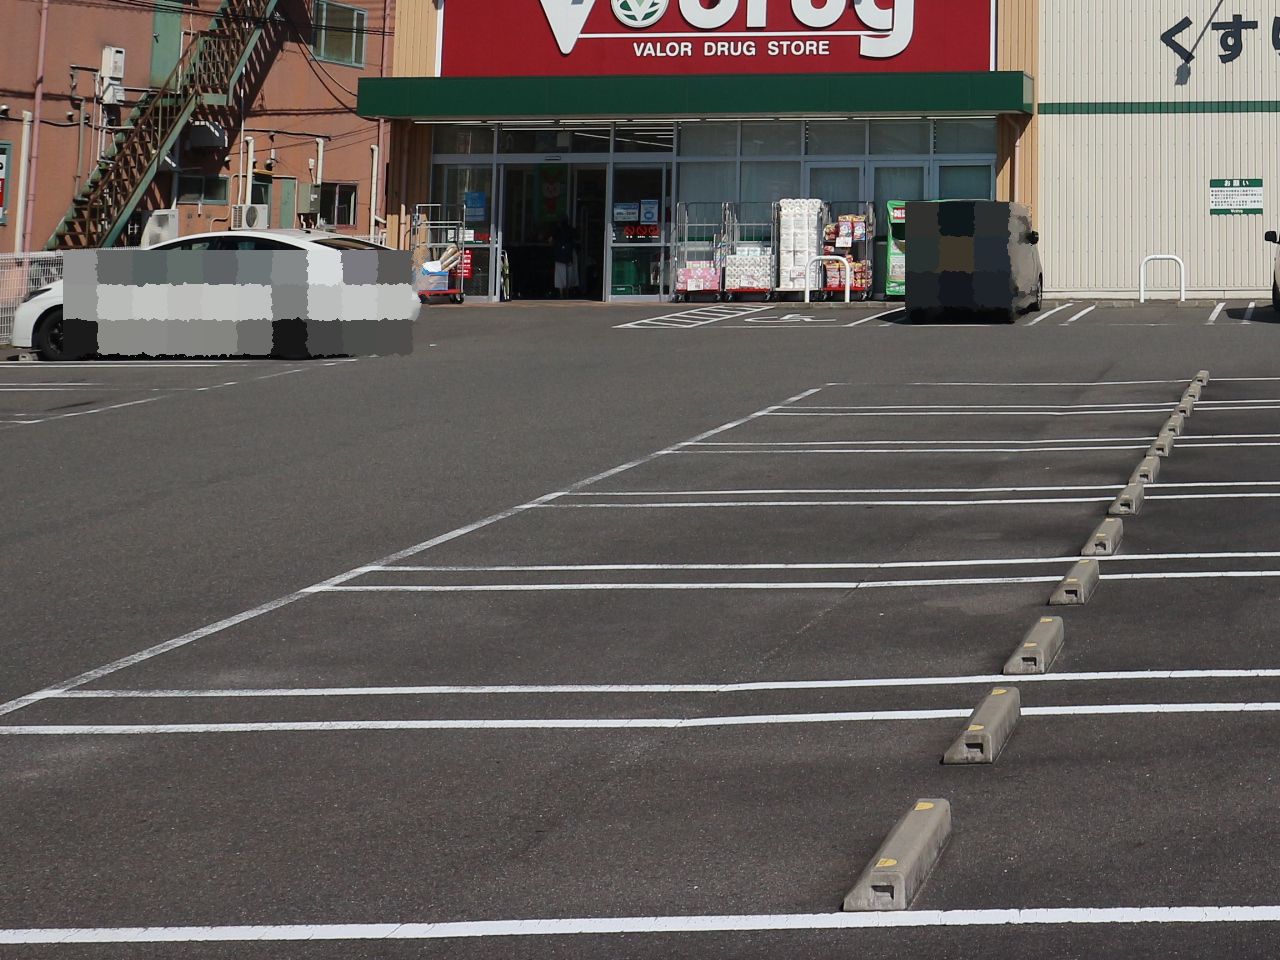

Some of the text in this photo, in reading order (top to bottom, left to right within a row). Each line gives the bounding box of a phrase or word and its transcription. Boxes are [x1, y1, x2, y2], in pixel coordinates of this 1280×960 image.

[633, 40, 830, 57] VALOR DRUG STORE
